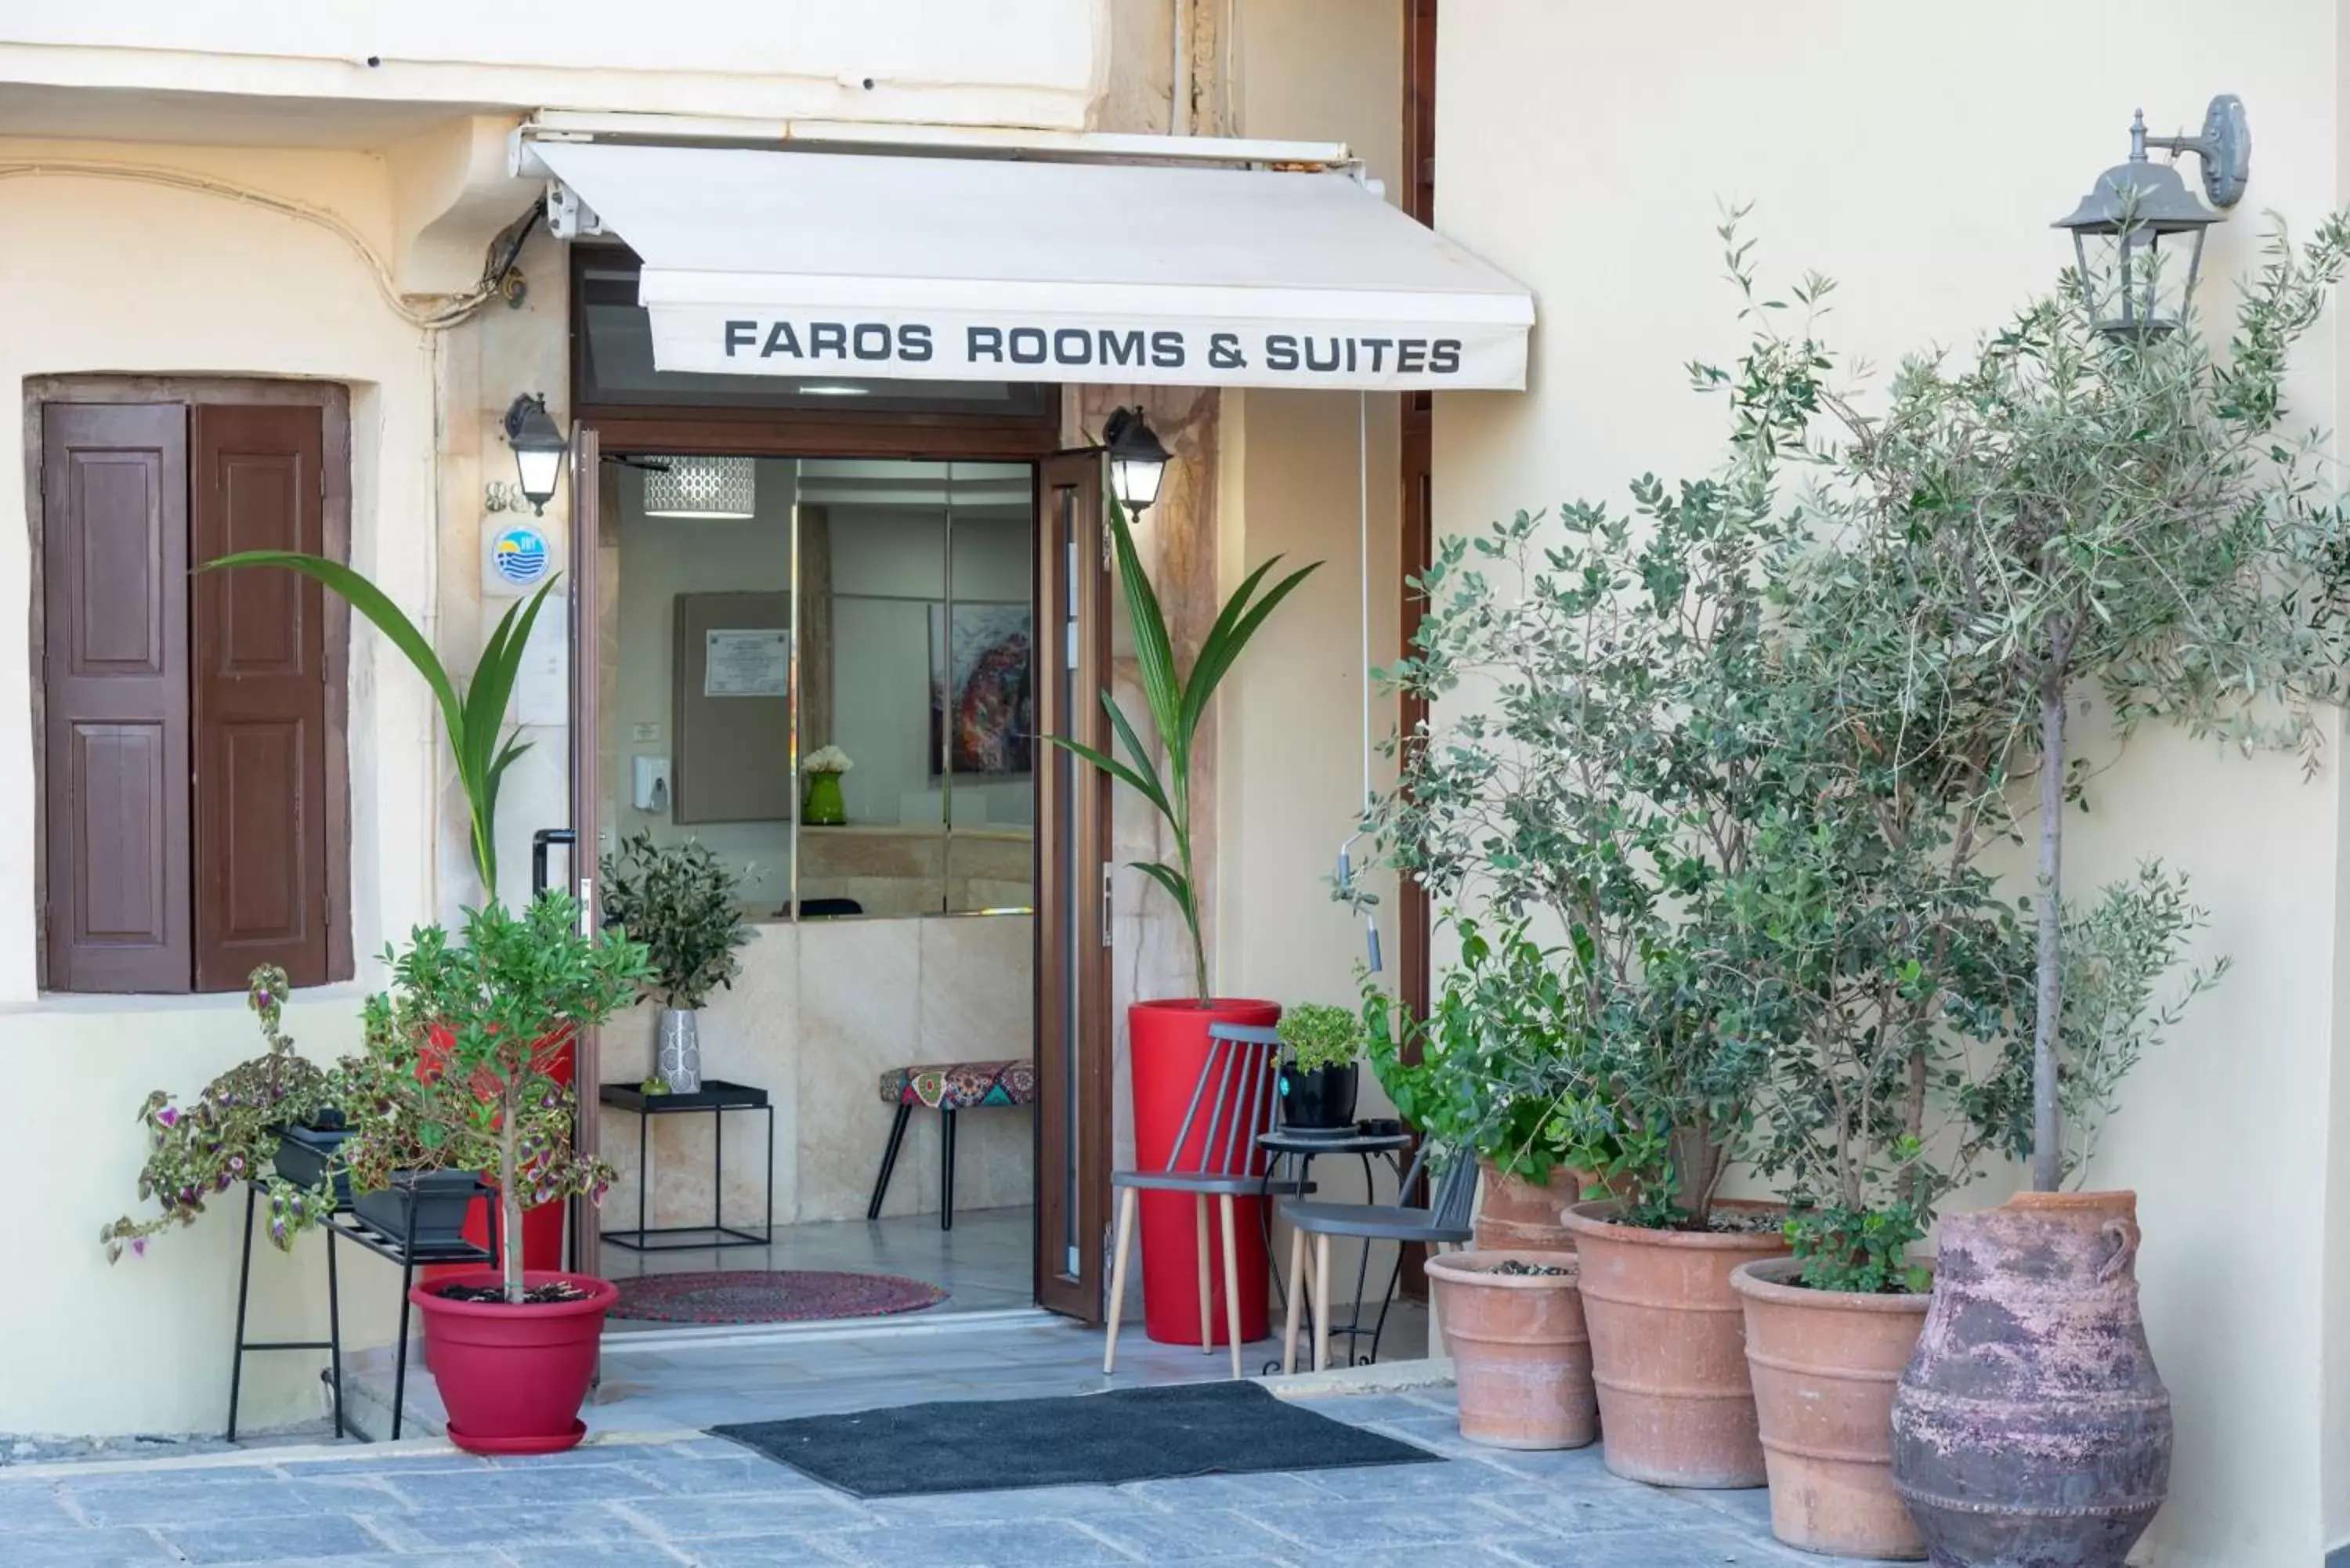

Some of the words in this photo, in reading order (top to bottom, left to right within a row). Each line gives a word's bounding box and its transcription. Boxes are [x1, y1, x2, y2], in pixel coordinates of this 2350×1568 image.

[725, 320, 933, 361] FAROS
[967, 327, 1185, 367] ROOMS
[1208, 333, 1248, 369] &
[1265, 334, 1462, 374] SUITES
